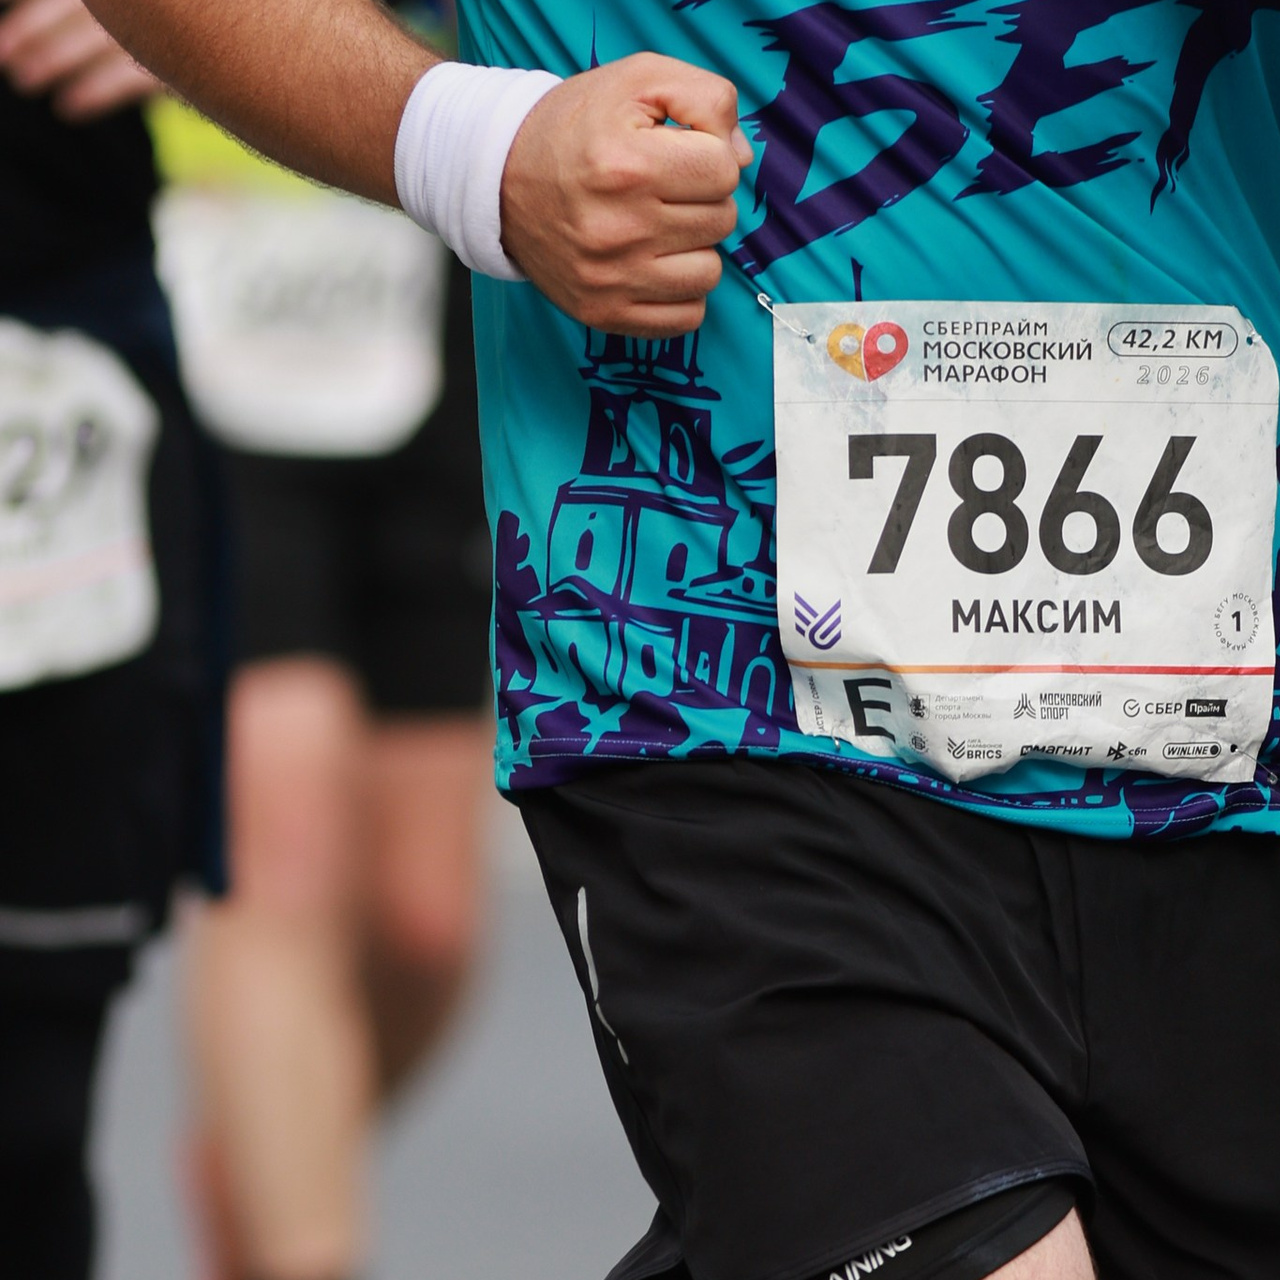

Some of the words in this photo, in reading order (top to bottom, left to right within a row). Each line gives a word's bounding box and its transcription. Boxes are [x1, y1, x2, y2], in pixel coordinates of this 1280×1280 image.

[922, 319, 1048, 336] СБЕРПРАЙМ
[922, 338, 1093, 360] МОСКОВСКИЙ
[1122, 328, 1176, 351] 42,2
[1185, 329, 1223, 349] КМ
[922, 364, 1047, 384] МАРАФОН
[1136, 364, 1210, 386] 2026
[847, 431, 1214, 577] 7866
[951, 598, 1122, 634] МАКСИМ
[1230, 609, 1242, 633] 1
[1039, 691, 1103, 707] МОСКОВСКИЙ
[1144, 701, 1183, 715] СБЕР
[1188, 702, 1221, 714] Прайм
[842, 677, 897, 743] E
[935, 712, 961, 721] города
[963, 711, 992, 719] Москвы
[1040, 707, 1070, 720] СПОРТ
[966, 749, 1003, 759] BRICS
[1166, 745, 1209, 757] WINLINE
